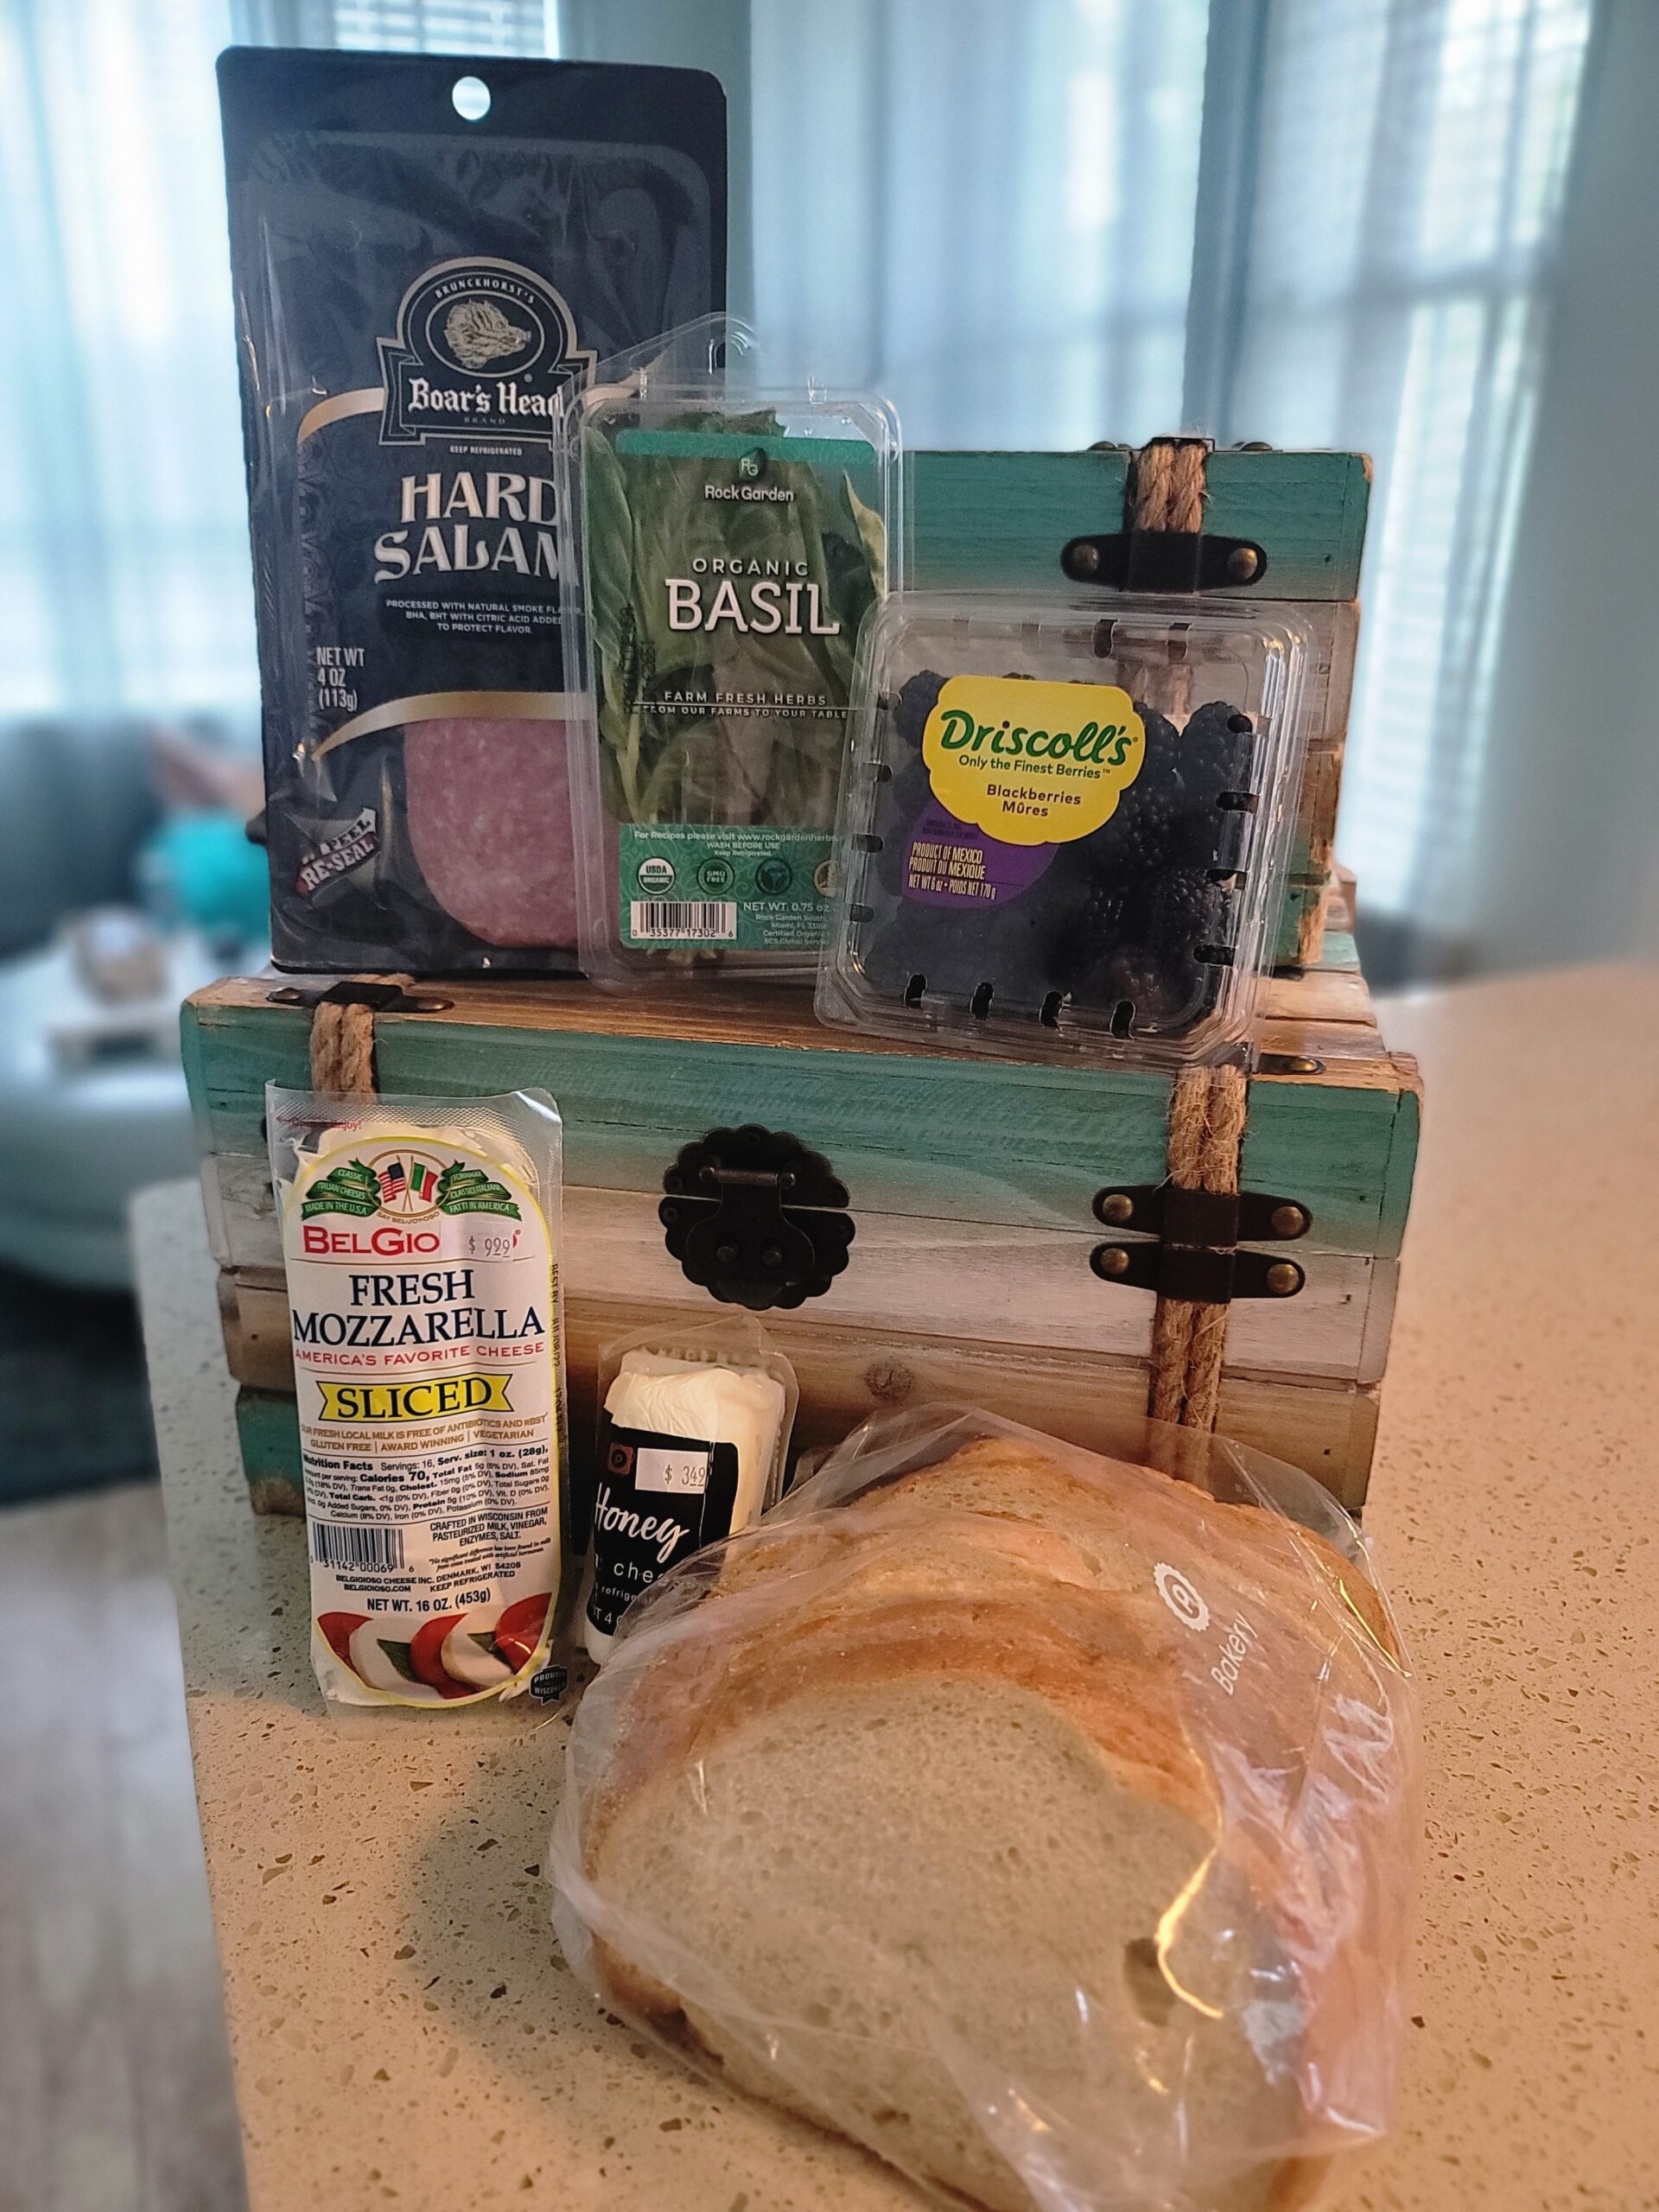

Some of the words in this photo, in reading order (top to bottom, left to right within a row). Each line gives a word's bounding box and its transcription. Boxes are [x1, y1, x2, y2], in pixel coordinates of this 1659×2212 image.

[435, 277, 535, 305] BRUNCKHORST'S
[407, 377, 491, 414] Boar's
[496, 381, 564, 418] Head
[464, 416, 506, 425] BRAND
[449, 445, 468, 454] KEEP
[470, 446, 523, 456] REFRIGERATED
[401, 472, 563, 526] HARD
[374, 524, 562, 584] SALAM
[692, 558, 808, 576] ORGANIC
[385, 600, 439, 610] PROCESSED
[441, 601, 466, 611] WITH
[467, 602, 510, 612] NATURAL
[512, 605, 543, 613] SMOKE
[664, 579, 841, 634] BASIL
[429, 612, 448, 621] BHT
[450, 613, 474, 622] WITH
[476, 614, 506, 623] CITRIC
[509, 615, 530, 624] ACID
[532, 616, 563, 625] ADDED
[436, 622, 450, 632] TO
[452, 623, 493, 632] PROTECT
[495, 625, 533, 634] FLAVOR.
[316, 646, 341, 665] NET
[344, 648, 365, 667] WT
[317, 667, 326, 686] 4
[328, 668, 346, 687] OZ
[319, 689, 358, 712] (113g)
[664, 691, 707, 702] FARM
[716, 692, 766, 704] FRESH
[774, 694, 826, 706] HERBS
[681, 706, 706, 715] OUR
[711, 707, 750, 716] FARMS
[754, 709, 770, 717] TO
[774, 709, 806, 718] YOUR
[811, 710, 848, 720] TABLE
[940, 709, 1132, 766] Driscoll's
[959, 754, 988, 771] Only
[990, 758, 1010, 771] the
[1014, 760, 1053, 774] Finest
[987, 784, 1082, 805] Blackberries
[1002, 800, 1049, 817] Mûres
[634, 830, 649, 840] For
[651, 831, 685, 842] Recipes
[687, 832, 715, 842] please
[717, 832, 735, 841] visit
[912, 842, 943, 858] PRODUCT
[943, 846, 952, 861] OF
[952, 847, 983, 864] MEXICO
[645, 865, 668, 874] USDA
[909, 856, 938, 874] PRODUIT
[938, 860, 948, 874] DU
[948, 861, 986, 880] MEXIQUE
[908, 874, 921, 888] NET
[921, 874, 931, 890] WT
[949, 879, 967, 894] POIDS
[967, 882, 980, 896] NET
[980, 883, 991, 898] 170
[743, 902, 766, 911] NET
[767, 902, 789, 912] WT.
[791, 903, 813, 912] 0.75
[338, 1168, 363, 1181] CLASSIC
[340, 1186, 365, 1199] CHEESES
[305, 1202, 324, 1211] MADE
[335, 1202, 349, 1211] THE
[449, 1203, 468, 1213] FATTI
[477, 1202, 510, 1212] AMERICA
[302, 1225, 440, 1255] BELGIO
[469, 1236, 475, 1255] $
[349, 1269, 475, 1306] FRESH
[292, 1306, 545, 1347] MOZZARELLA
[296, 1349, 377, 1365] AMERICA'S
[385, 1345, 471, 1365] FAVORITE
[476, 1341, 545, 1357] CHEESE
[336, 1377, 493, 1419] SLICED
[313, 1427, 340, 1438] FRESH
[341, 1431, 372, 1440] LOCAL
[372, 1431, 396, 1440] MILK
[406, 1428, 432, 1439] FREE
[432, 1426, 446, 1435] OF
[447, 1418, 501, 1433] ANTIBIOTICS
[502, 1419, 523, 1428] AND
[310, 1439, 345, 1450] GLUTEN
[346, 1443, 372, 1452] FREE
[380, 1442, 418, 1452] AWARD
[419, 1434, 465, 1449] WINNING
[474, 1429, 534, 1440] VEGETARIAN
[303, 1453, 340, 1469] Nutrition
[343, 1460, 374, 1471] Facts
[381, 1462, 420, 1471] Servings:
[437, 1455, 462, 1465] Serv.
[464, 1450, 487, 1459] size:
[359, 1473, 404, 1483] Calories
[409, 1471, 429, 1482] 70,
[432, 1468, 455, 1478] Total
[458, 1465, 472, 1473] Fat
[664, 1465, 672, 1484] $
[430, 1519, 467, 1531] CRAFTED
[478, 1511, 524, 1522] WISCONSIN
[525, 1507, 548, 1519] FROM
[433, 1523, 485, 1541] PASTEURIZED
[486, 1522, 509, 1531] MILK,
[510, 1517, 547, 1529] VINEGAR,
[594, 1482, 690, 1564] Honey
[459, 1532, 499, 1547] ENZYMES,
[499, 1531, 521, 1540] SALT.
[323, 1559, 355, 1571] 31142
[359, 1562, 394, 1573] 00069
[335, 1574, 382, 1584] BELGIOIOSO
[436, 1567, 480, 1582] DENMARK,
[613, 1561, 663, 1583] che
[429, 1583, 453, 1592] KEEP
[454, 1570, 516, 1587] REFRIGERATED
[367, 1599, 389, 1611] NET
[392, 1599, 413, 1611] WT.
[416, 1600, 430, 1611] 16
[433, 1598, 453, 1611] OZ.
[454, 1587, 492, 1610] (453g)
[601, 1586, 637, 1601] refrige
[1211, 1611, 1259, 1696] Bakery
